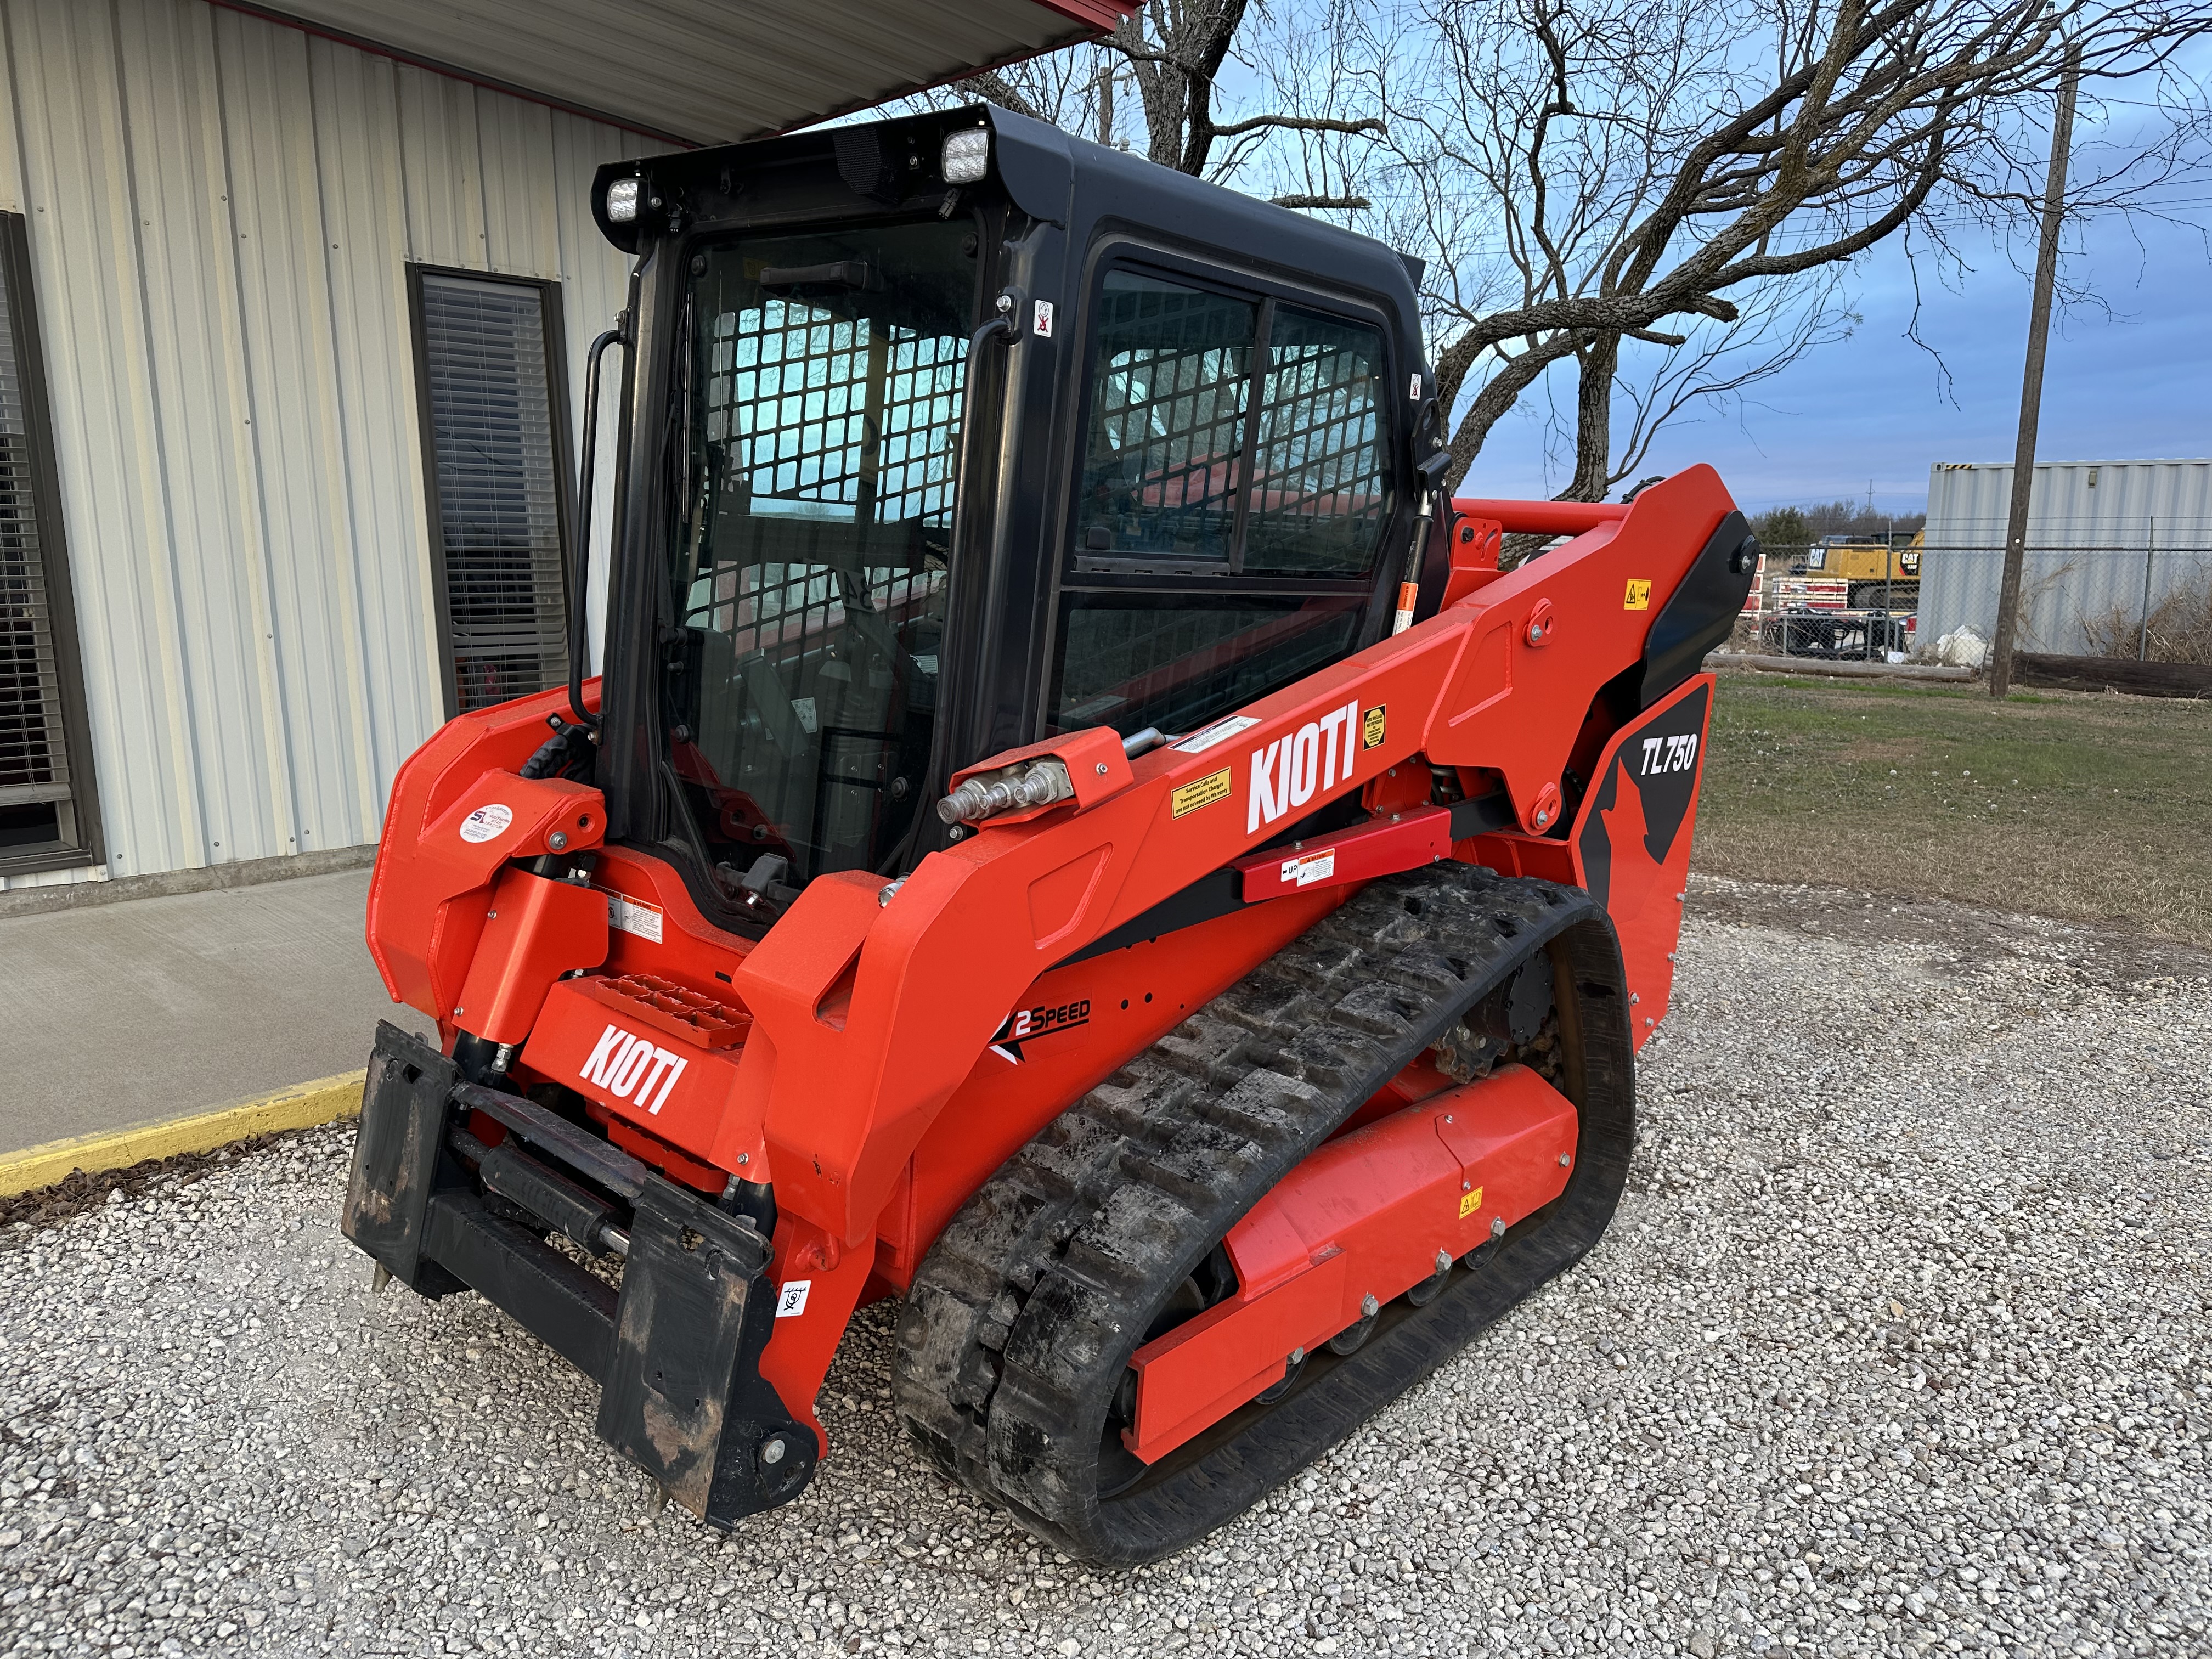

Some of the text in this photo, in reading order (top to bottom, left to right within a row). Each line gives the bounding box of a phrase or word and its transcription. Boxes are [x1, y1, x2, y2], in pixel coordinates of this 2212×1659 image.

[1810, 549, 1825, 567] CAT
[1902, 553, 1918, 564] CAT
[1641, 733, 1697, 776] TL750
[1247, 699, 1358, 834] KIOTI
[1180, 782, 1223, 804] Transportation Charges
[1186, 784, 1200, 793] Service
[1190, 797, 1205, 808] covered
[1211, 788, 1228, 799] Warranty
[489, 815, 510, 823] SOUTHERN
[1288, 865, 1297, 874] UP
[579, 1024, 689, 1115] KIOTI
